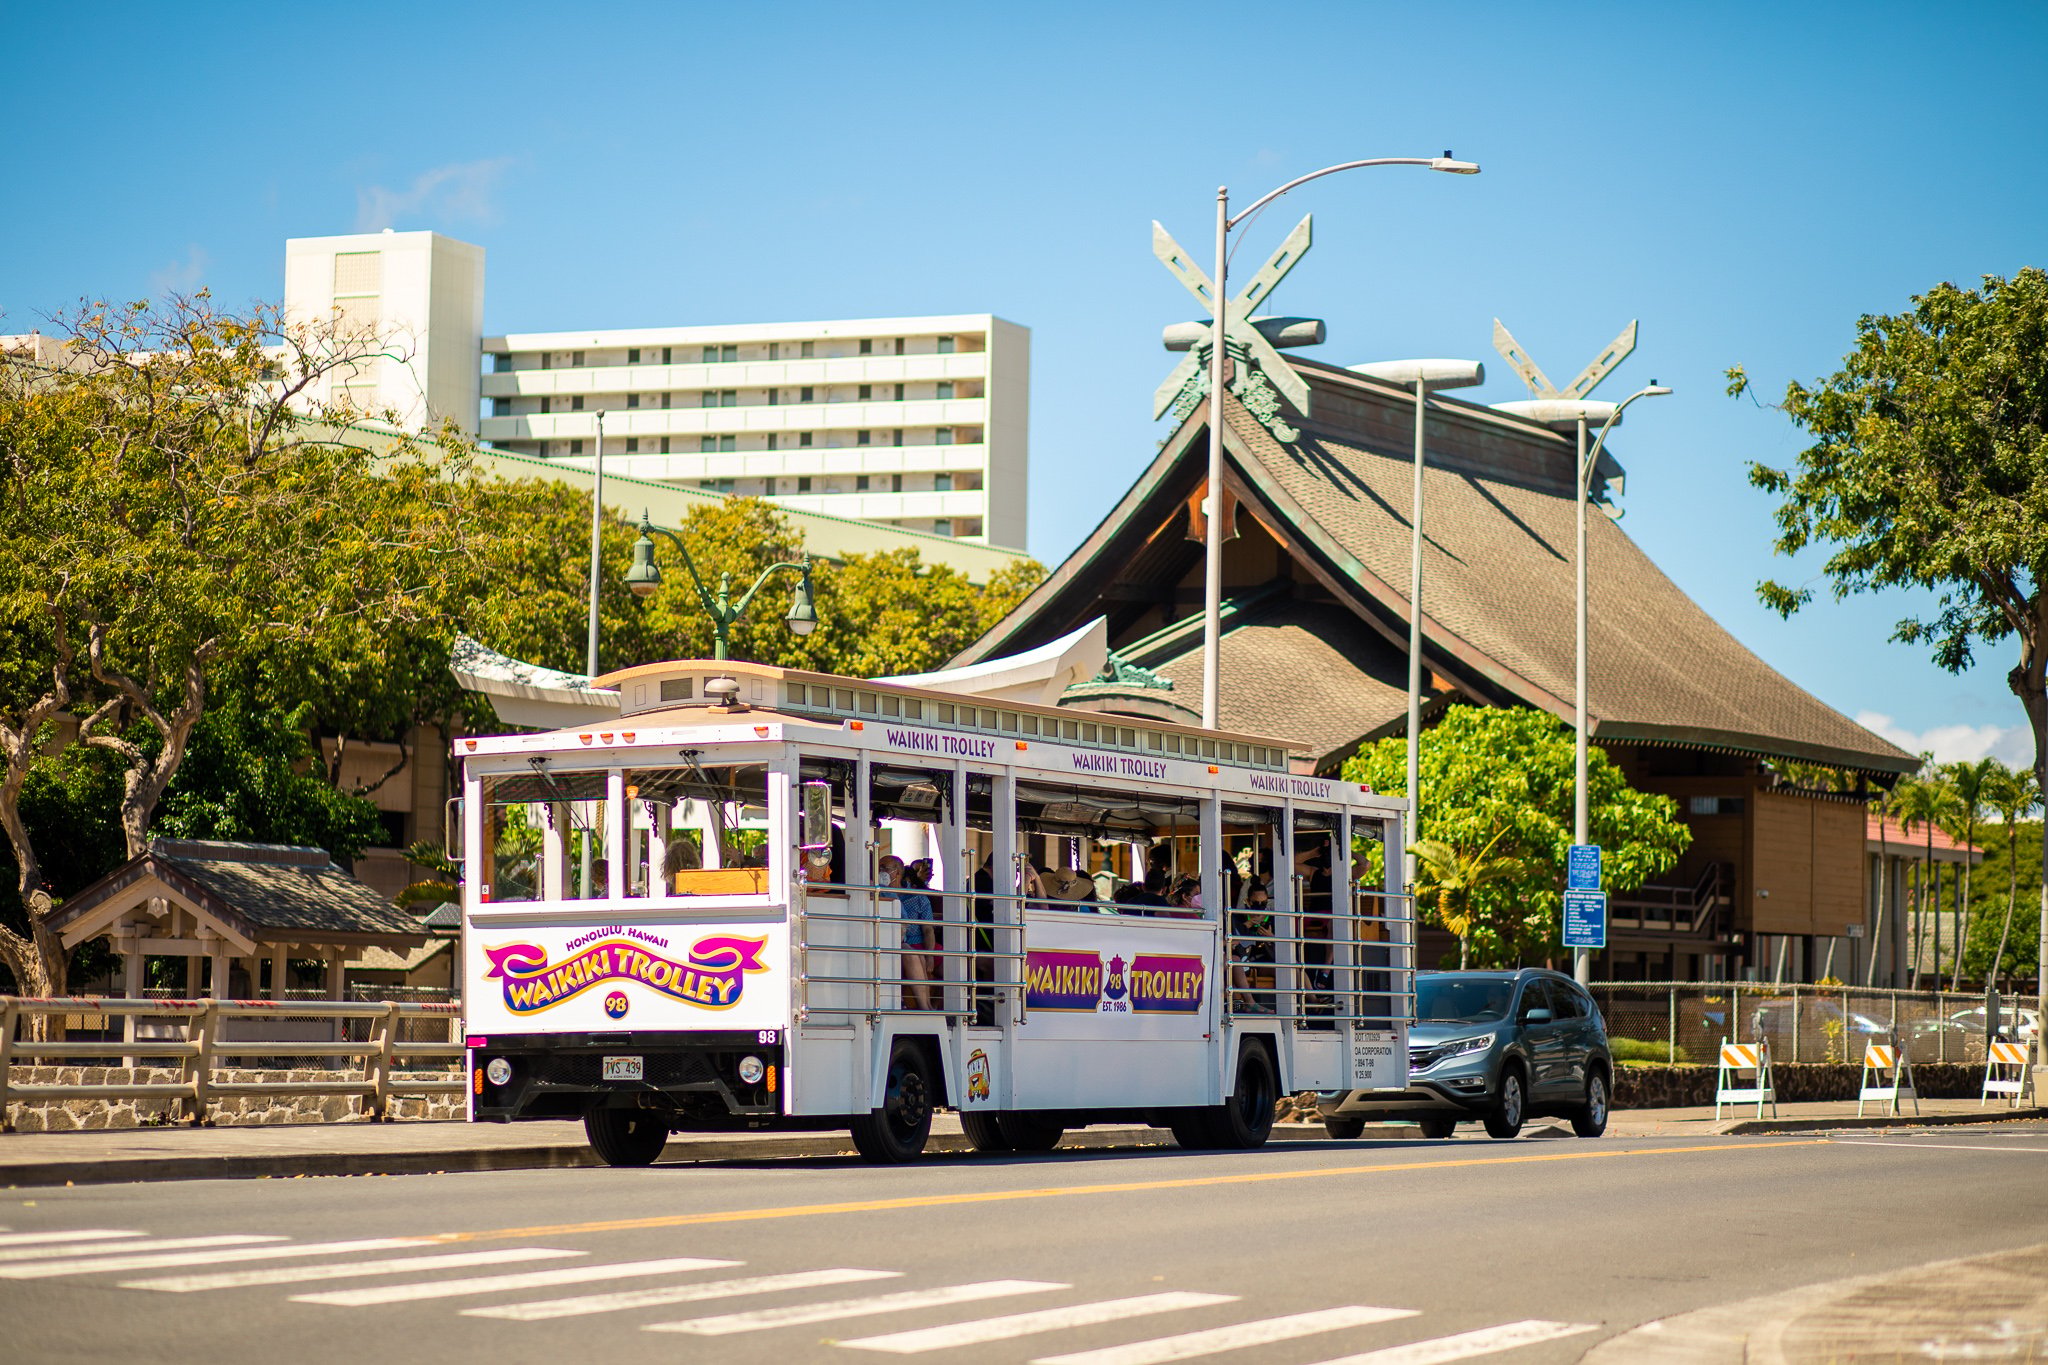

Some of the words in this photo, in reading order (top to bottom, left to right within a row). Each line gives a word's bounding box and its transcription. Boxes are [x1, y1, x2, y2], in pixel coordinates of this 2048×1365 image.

[887, 729, 938, 752] WAIKIKI
[942, 736, 995, 758] TROLLEY
[1072, 753, 1117, 773] WAIKIKI
[1120, 758, 1167, 779] TROLLEY
[1250, 774, 1288, 793] WAIKIKI
[1291, 779, 1331, 798] TROLLEY
[628, 928, 669, 949] HAWAII
[508, 949, 611, 1009] WAIKIKI
[614, 947, 737, 1003] TROLLEY
[1025, 965, 1100, 995] WAIKIKI
[1131, 970, 1203, 999] TROLLEY
[1110, 973, 1122, 990] 98
[605, 996, 627, 1013] 98
[1102, 1001, 1112, 1012] EST.
[1113, 1002, 1127, 1013] 1986
[758, 1030, 776, 1044] 98
[1362, 1047, 1392, 1056] CORPORATION
[604, 1061, 621, 1074] TVS
[625, 1061, 641, 1074] 439
